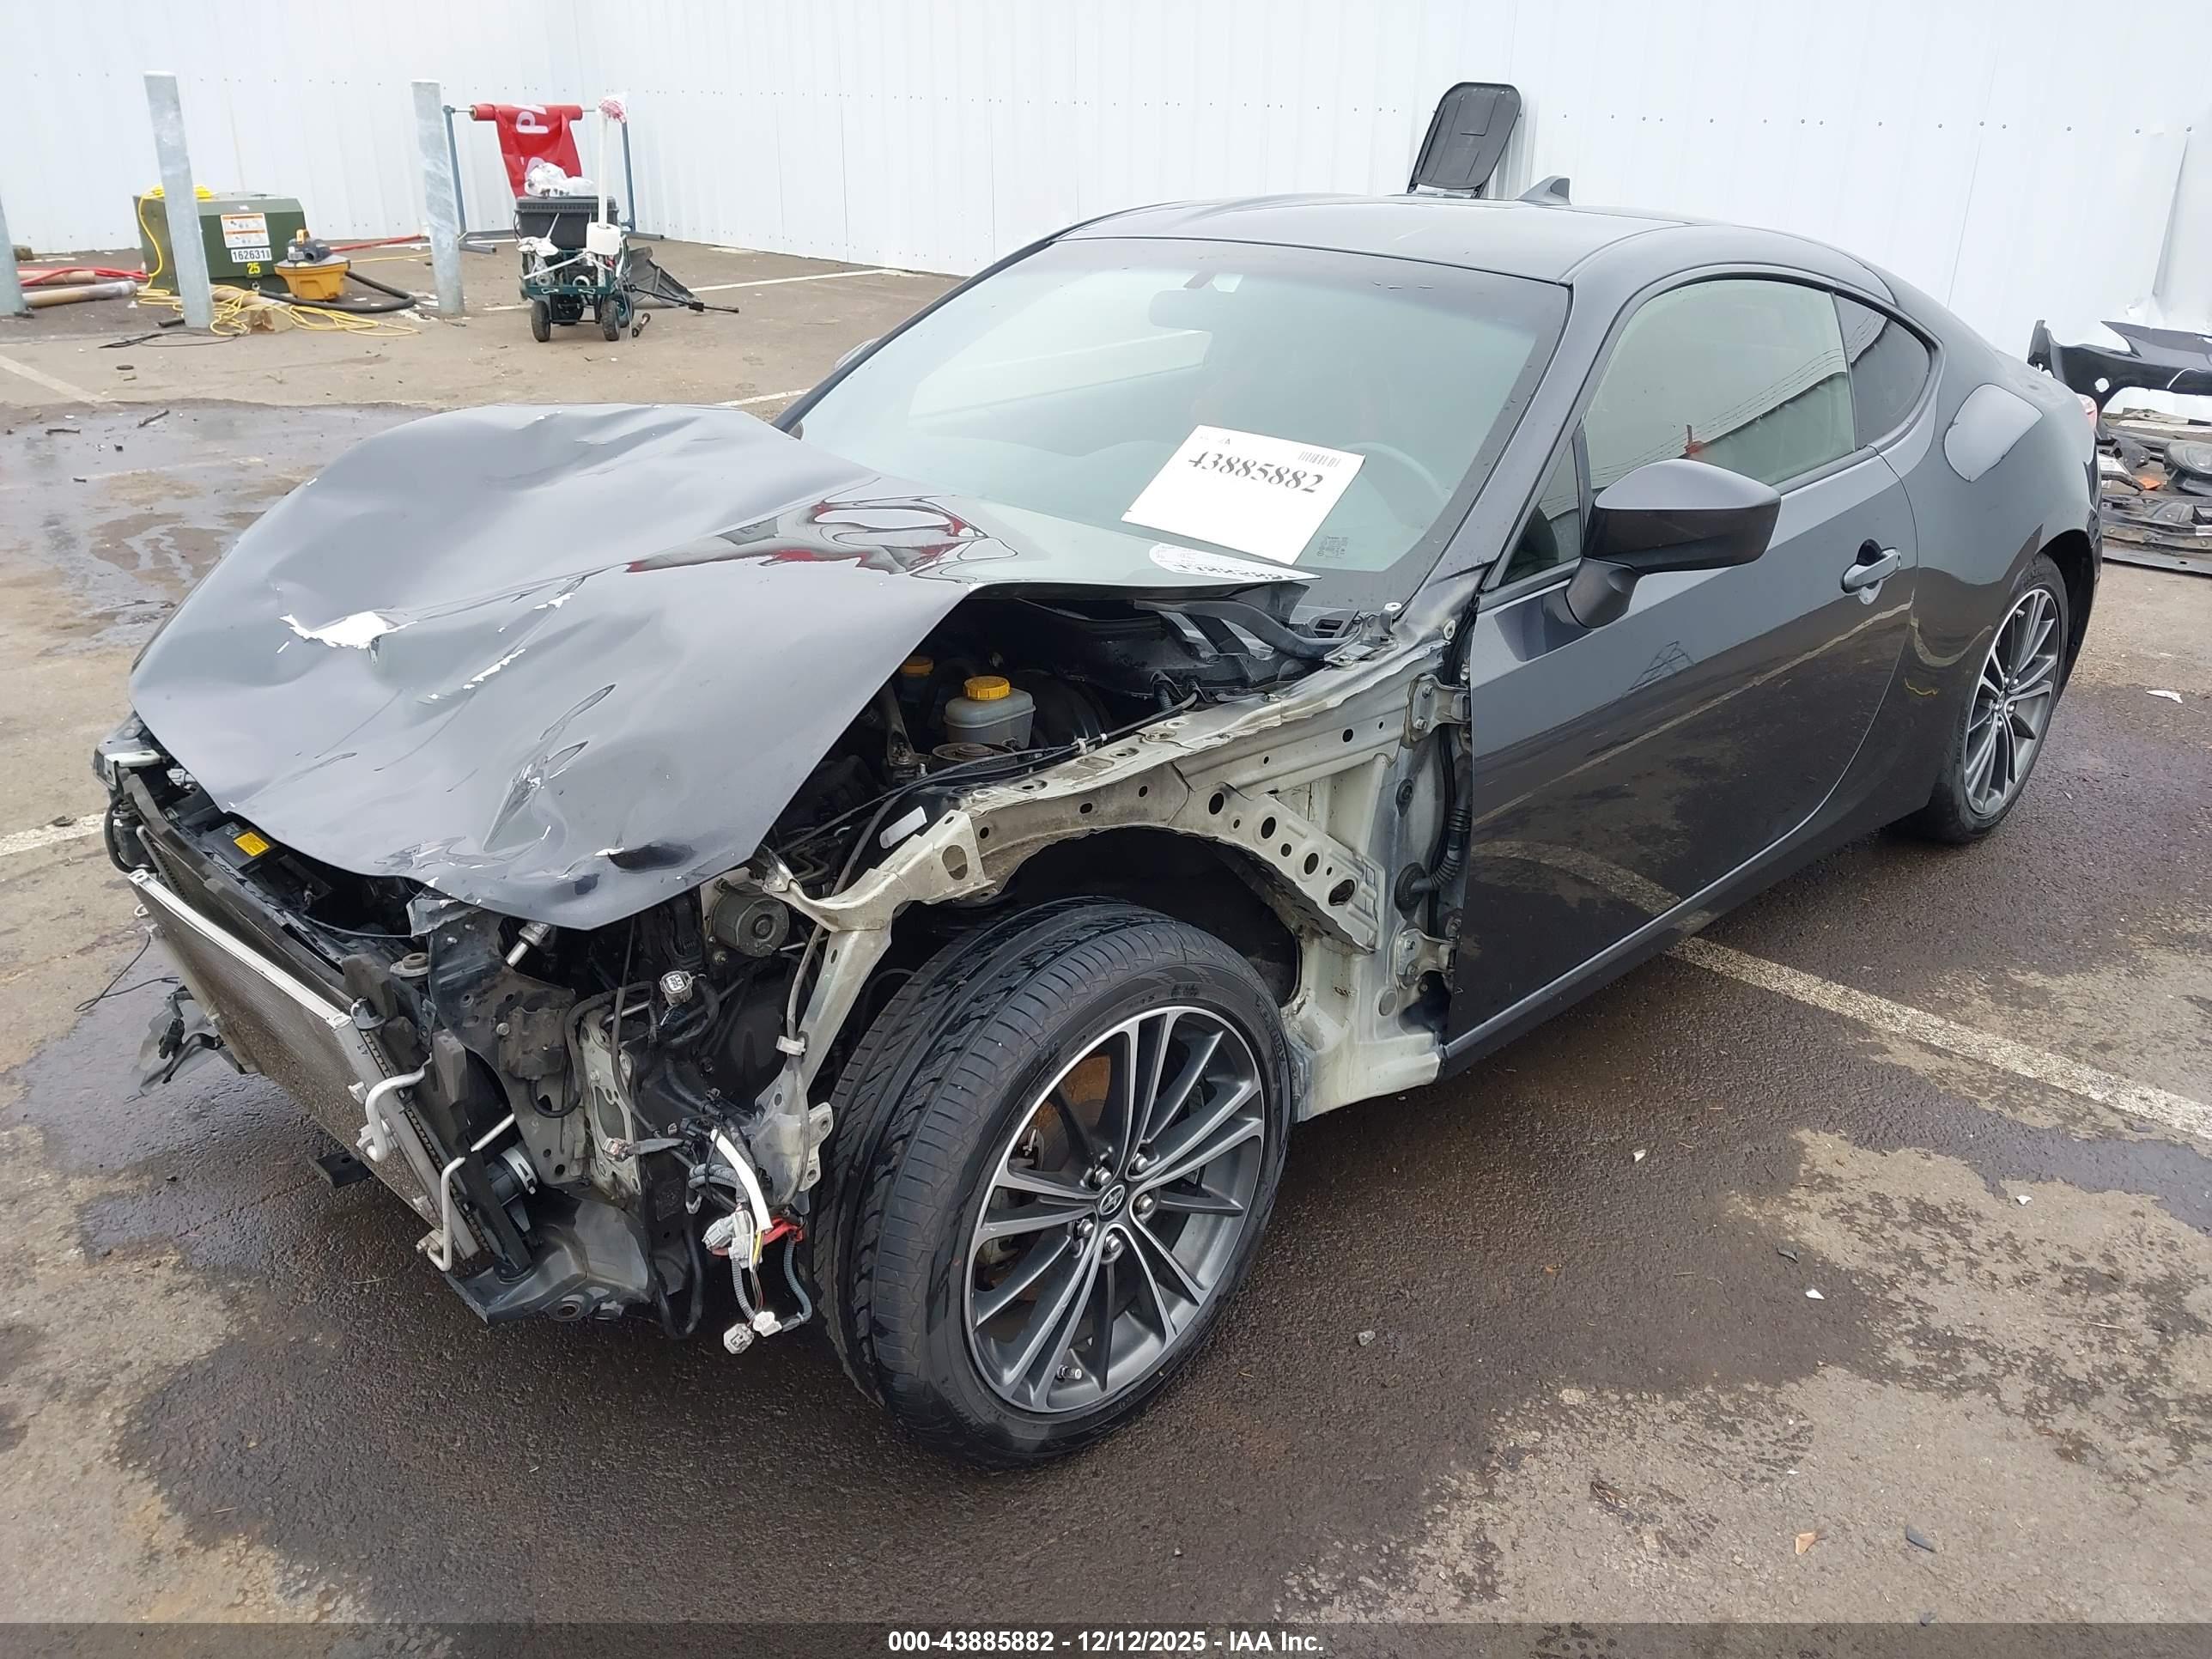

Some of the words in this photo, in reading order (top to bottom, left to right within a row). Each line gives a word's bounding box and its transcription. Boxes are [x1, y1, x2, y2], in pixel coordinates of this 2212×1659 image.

[233, 250, 265, 260] 162631
[247, 263, 260, 274] 25
[1188, 451, 1324, 493] 43885882
